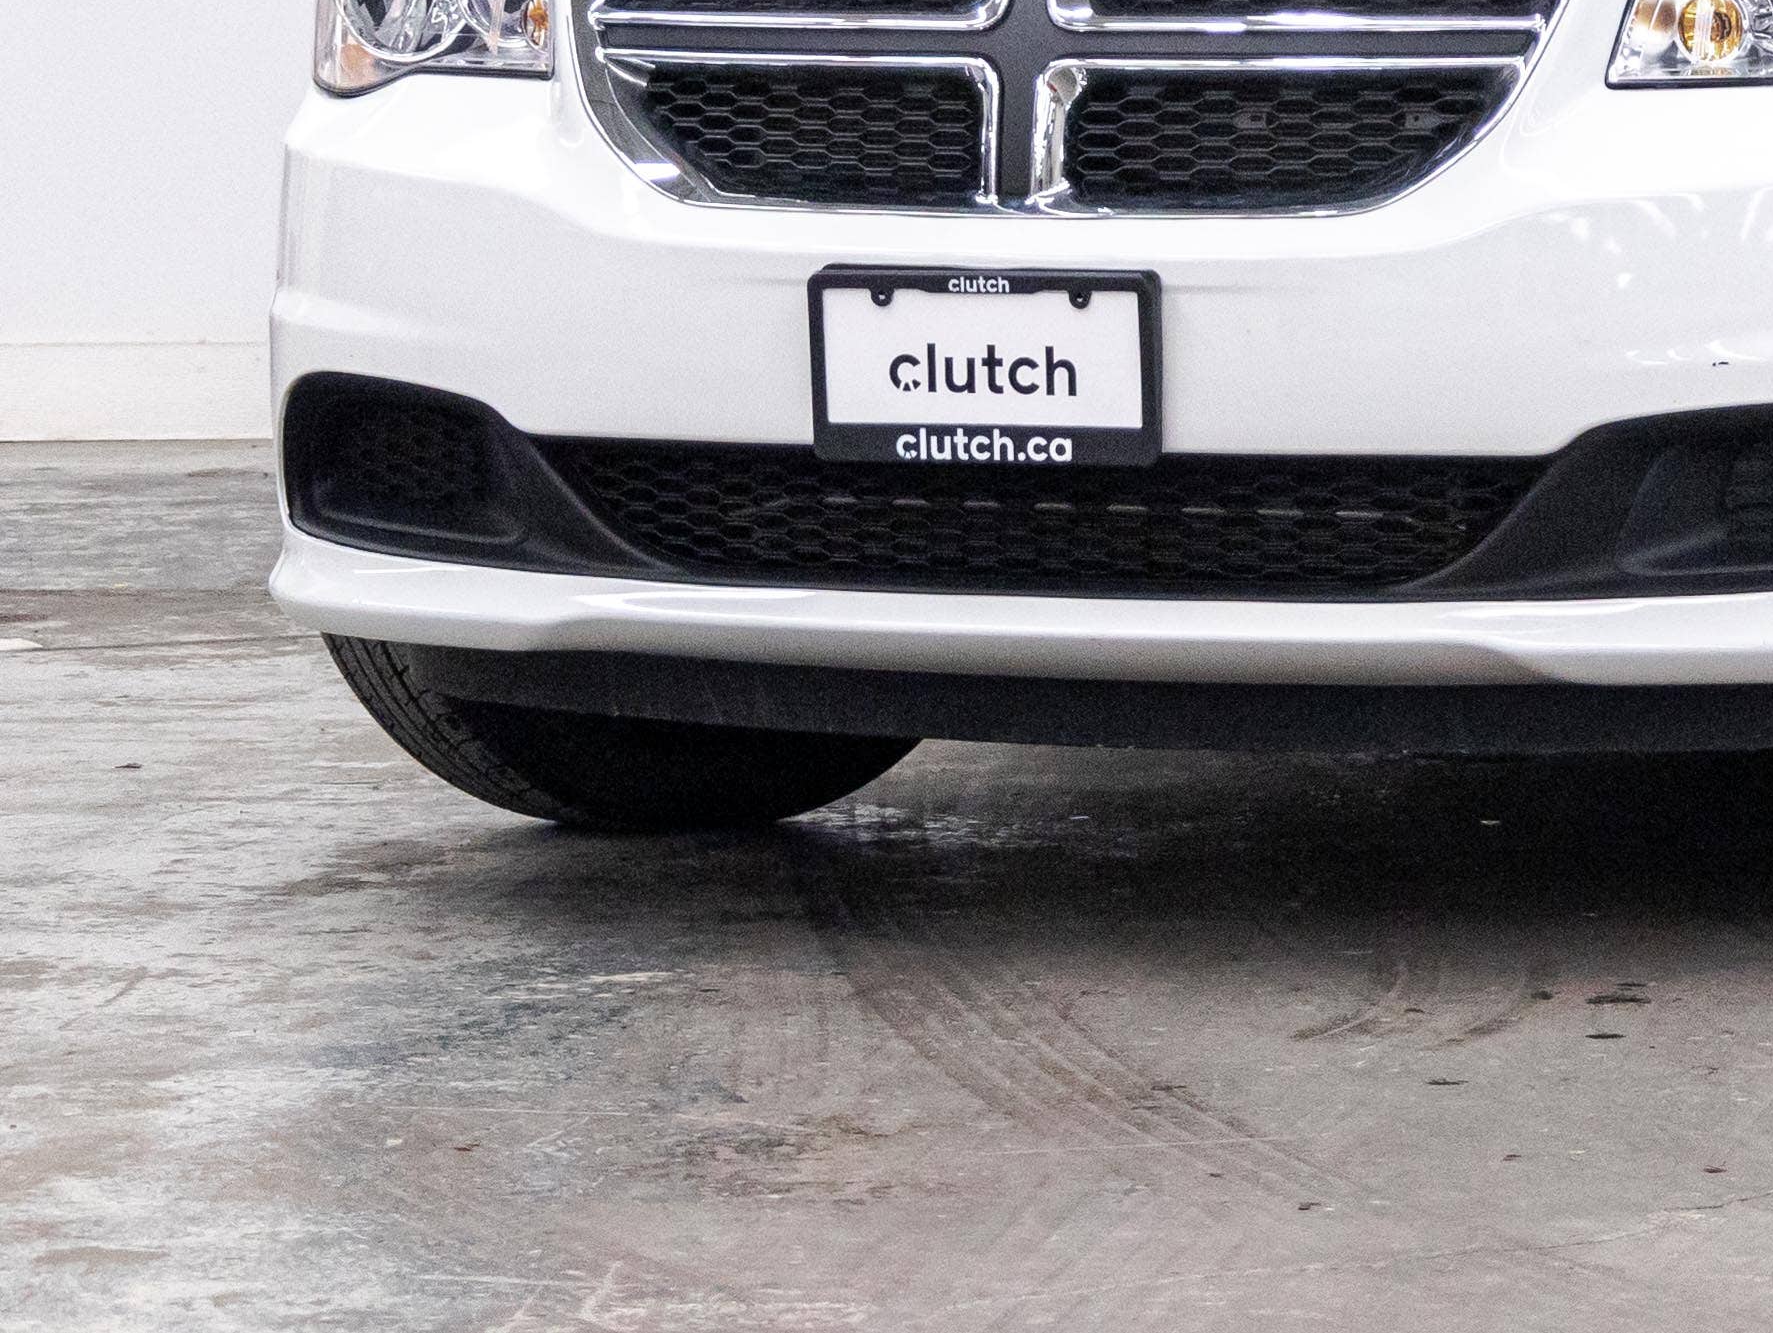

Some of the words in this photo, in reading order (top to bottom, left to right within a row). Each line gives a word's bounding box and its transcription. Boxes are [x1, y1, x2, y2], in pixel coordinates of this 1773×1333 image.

[948, 276, 1010, 293] clutch
[889, 343, 1077, 396] clutch
[896, 427, 1073, 462] clutch.ca
